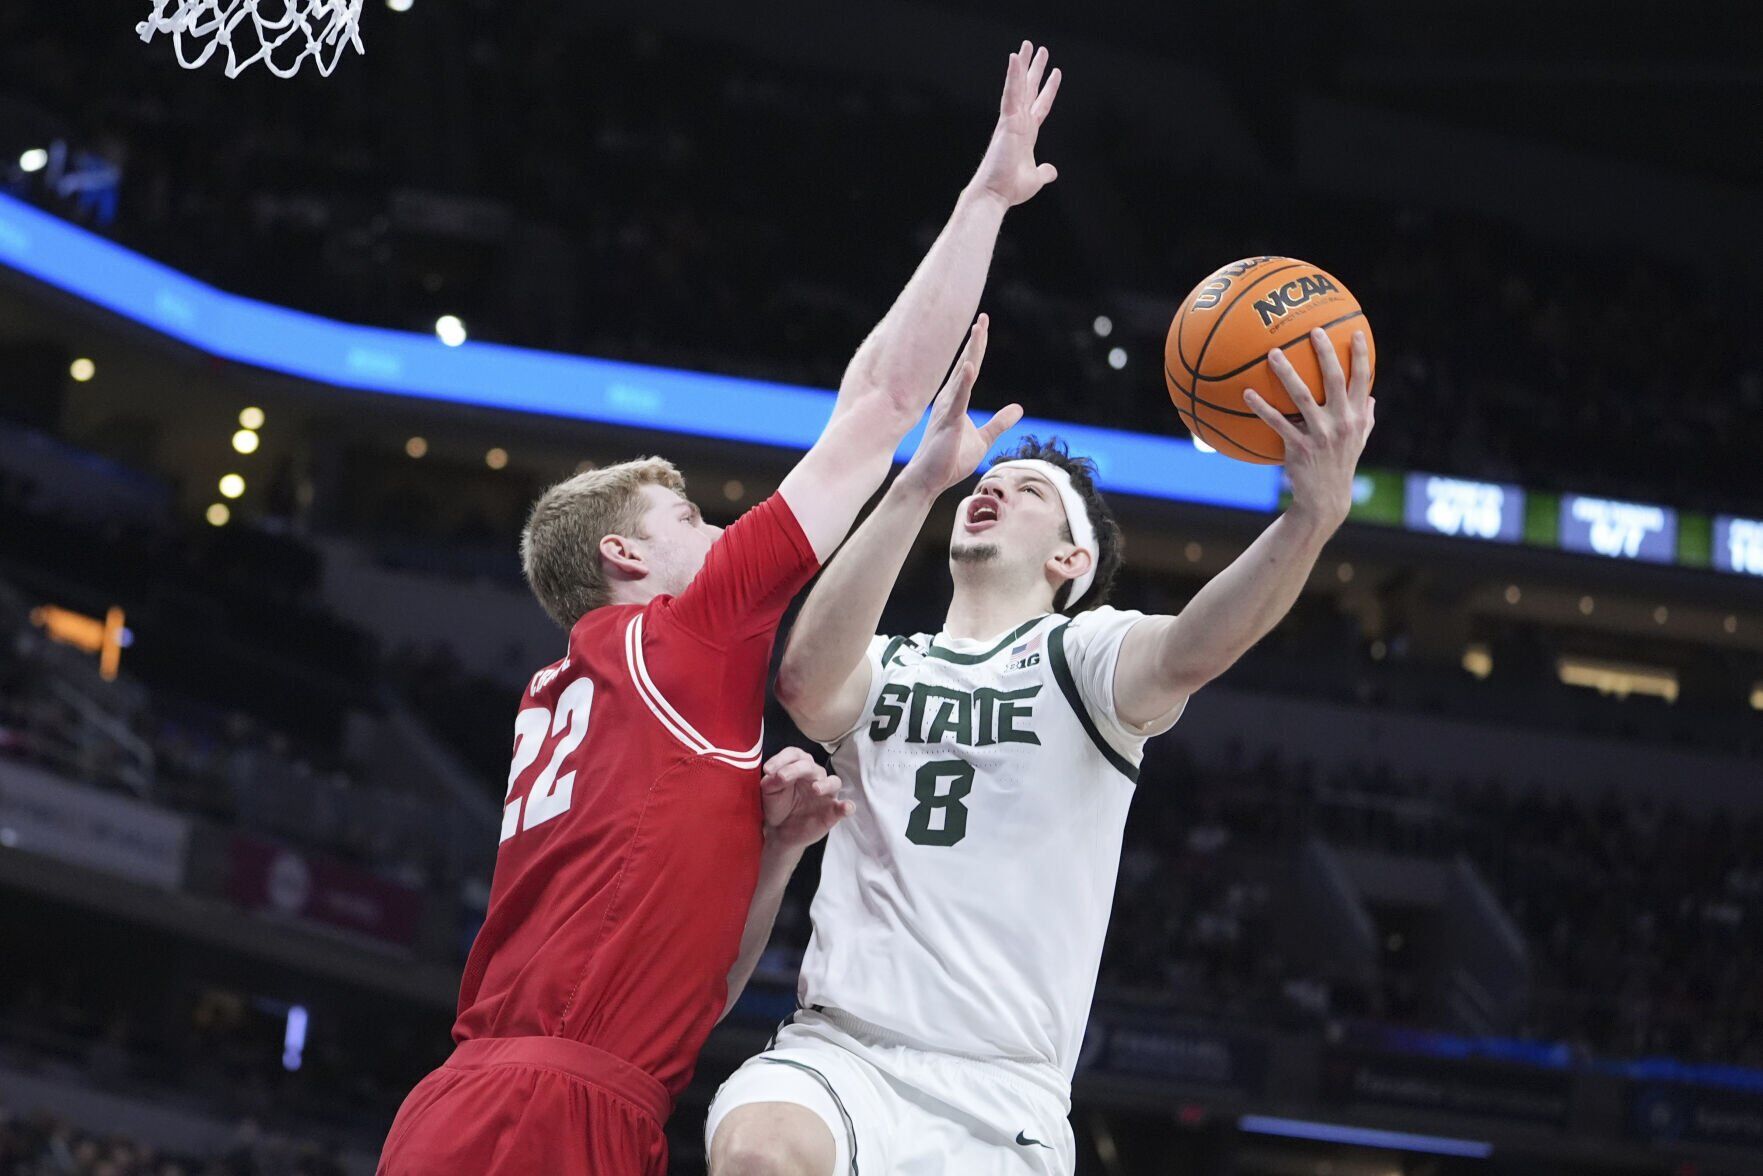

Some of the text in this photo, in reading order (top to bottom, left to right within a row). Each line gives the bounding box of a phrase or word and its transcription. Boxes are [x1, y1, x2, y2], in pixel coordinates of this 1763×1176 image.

[1253, 274, 1339, 328] NCAA
[869, 682, 1043, 747] STATE
[499, 677, 594, 846] 22
[904, 759, 976, 847] 8
